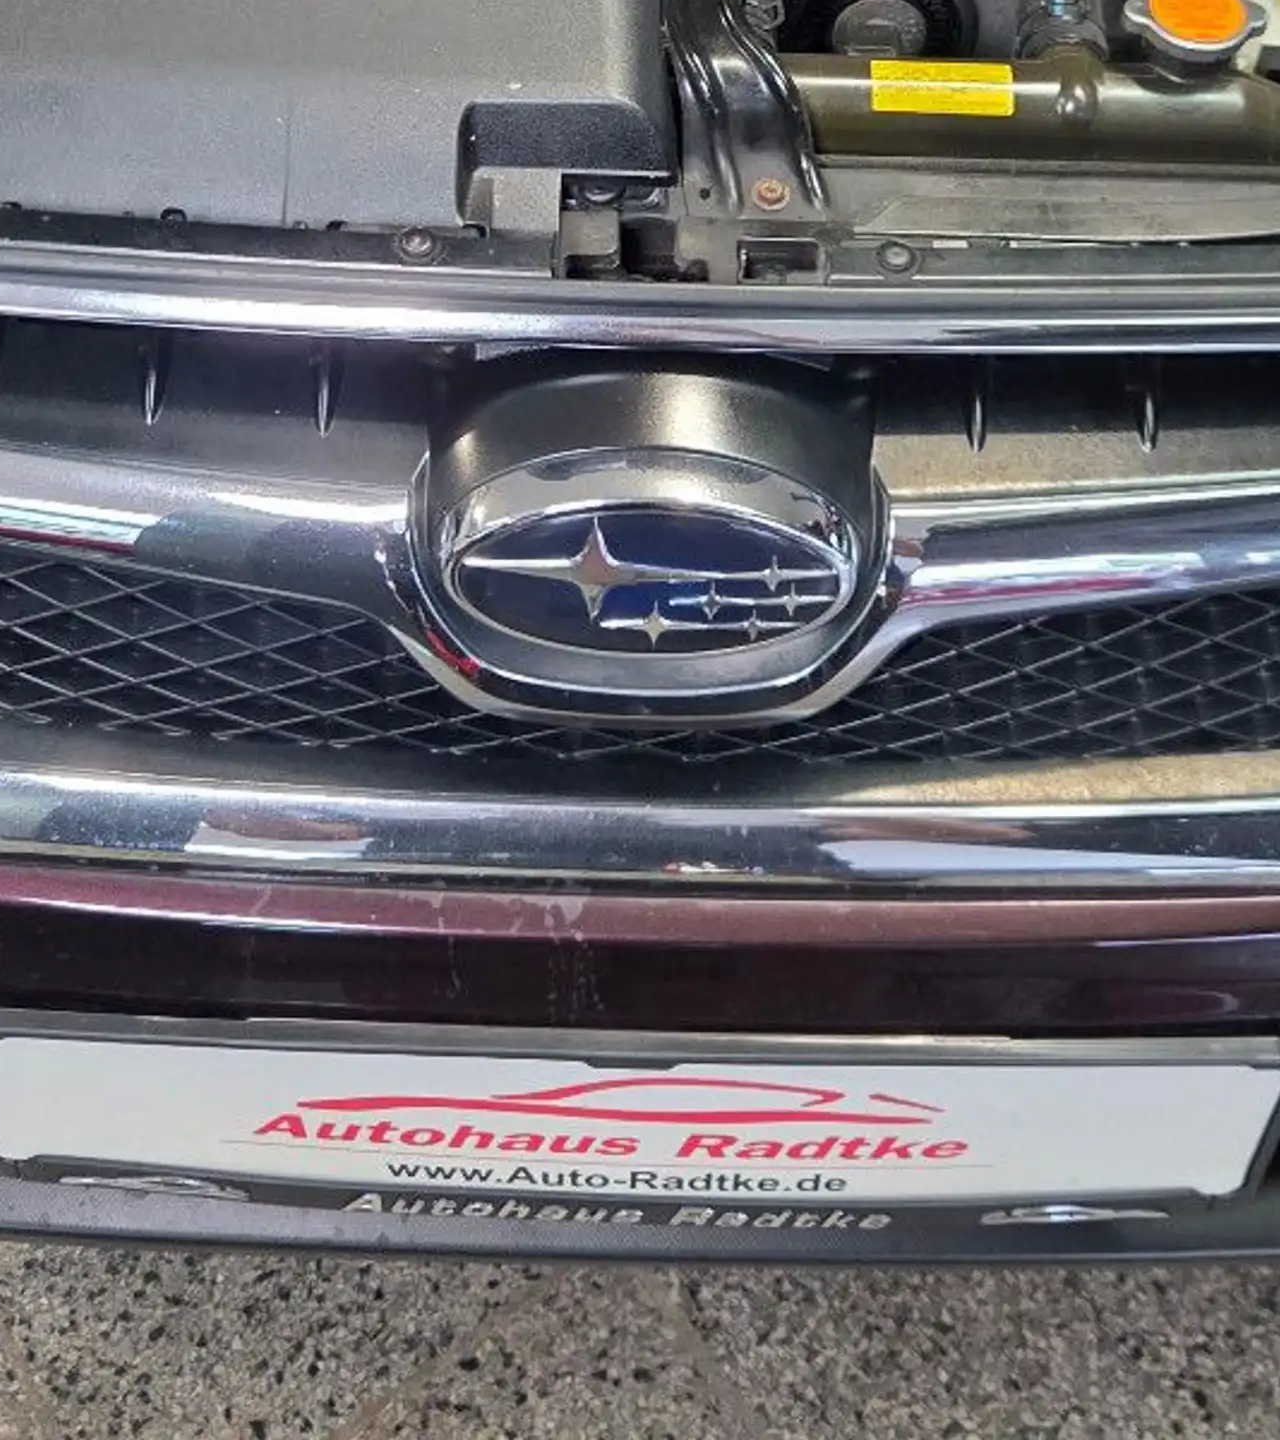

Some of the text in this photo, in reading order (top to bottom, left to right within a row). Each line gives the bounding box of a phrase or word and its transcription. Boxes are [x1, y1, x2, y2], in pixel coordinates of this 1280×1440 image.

[254, 1114, 970, 1160] Autohaus Radtke
[387, 1162, 848, 1192] www.Auto-Radtke.de
[342, 1192, 892, 1230] Autohaus Radtke
